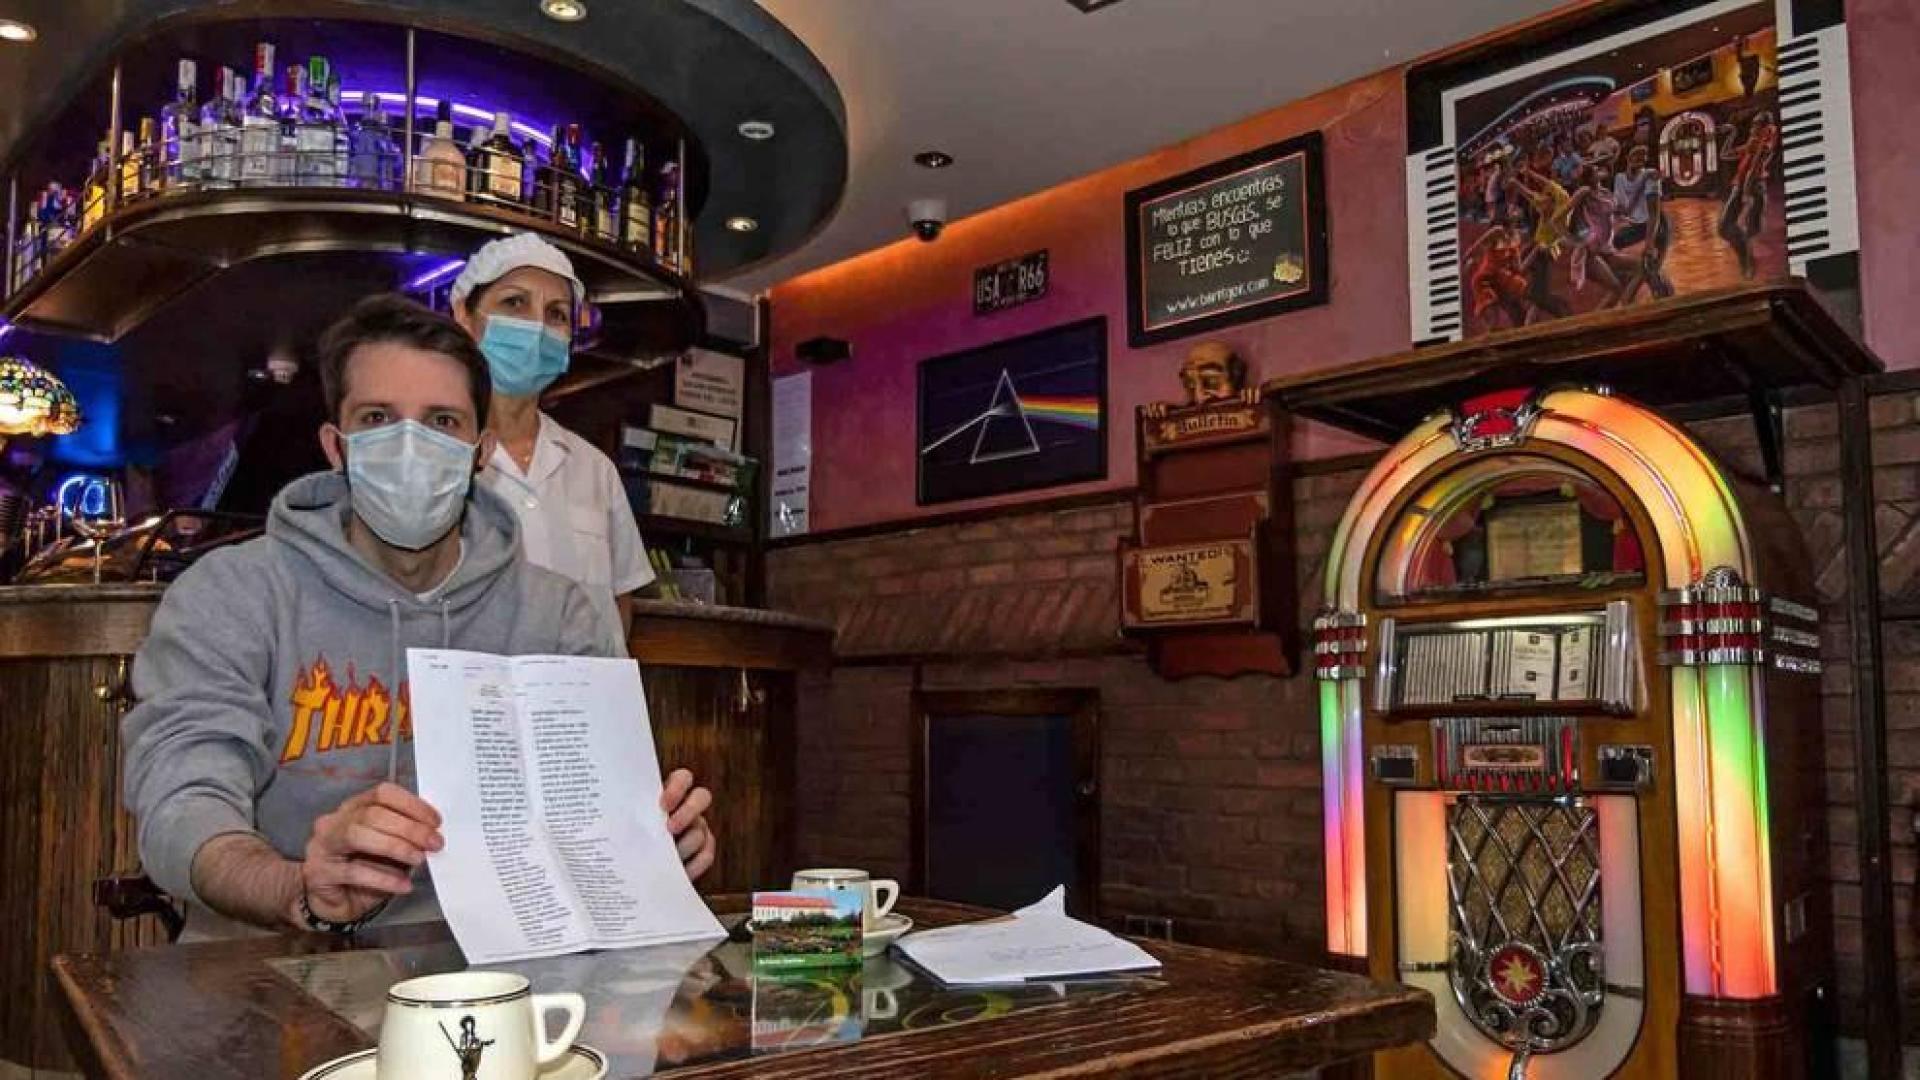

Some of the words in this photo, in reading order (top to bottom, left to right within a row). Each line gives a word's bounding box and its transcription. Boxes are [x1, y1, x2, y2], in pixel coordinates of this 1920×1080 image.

[1211, 174, 1284, 207] encuentras
[1167, 223, 1178, 236] lo
[1181, 219, 1200, 235] que
[1266, 195, 1281, 210] se
[1153, 237, 1192, 262] FELIZ
[1200, 234, 1220, 249] con
[1229, 228, 1240, 241] lo
[1249, 219, 1273, 240] que
[977, 273, 1000, 307] USA
[1018, 262, 1045, 291] R66
